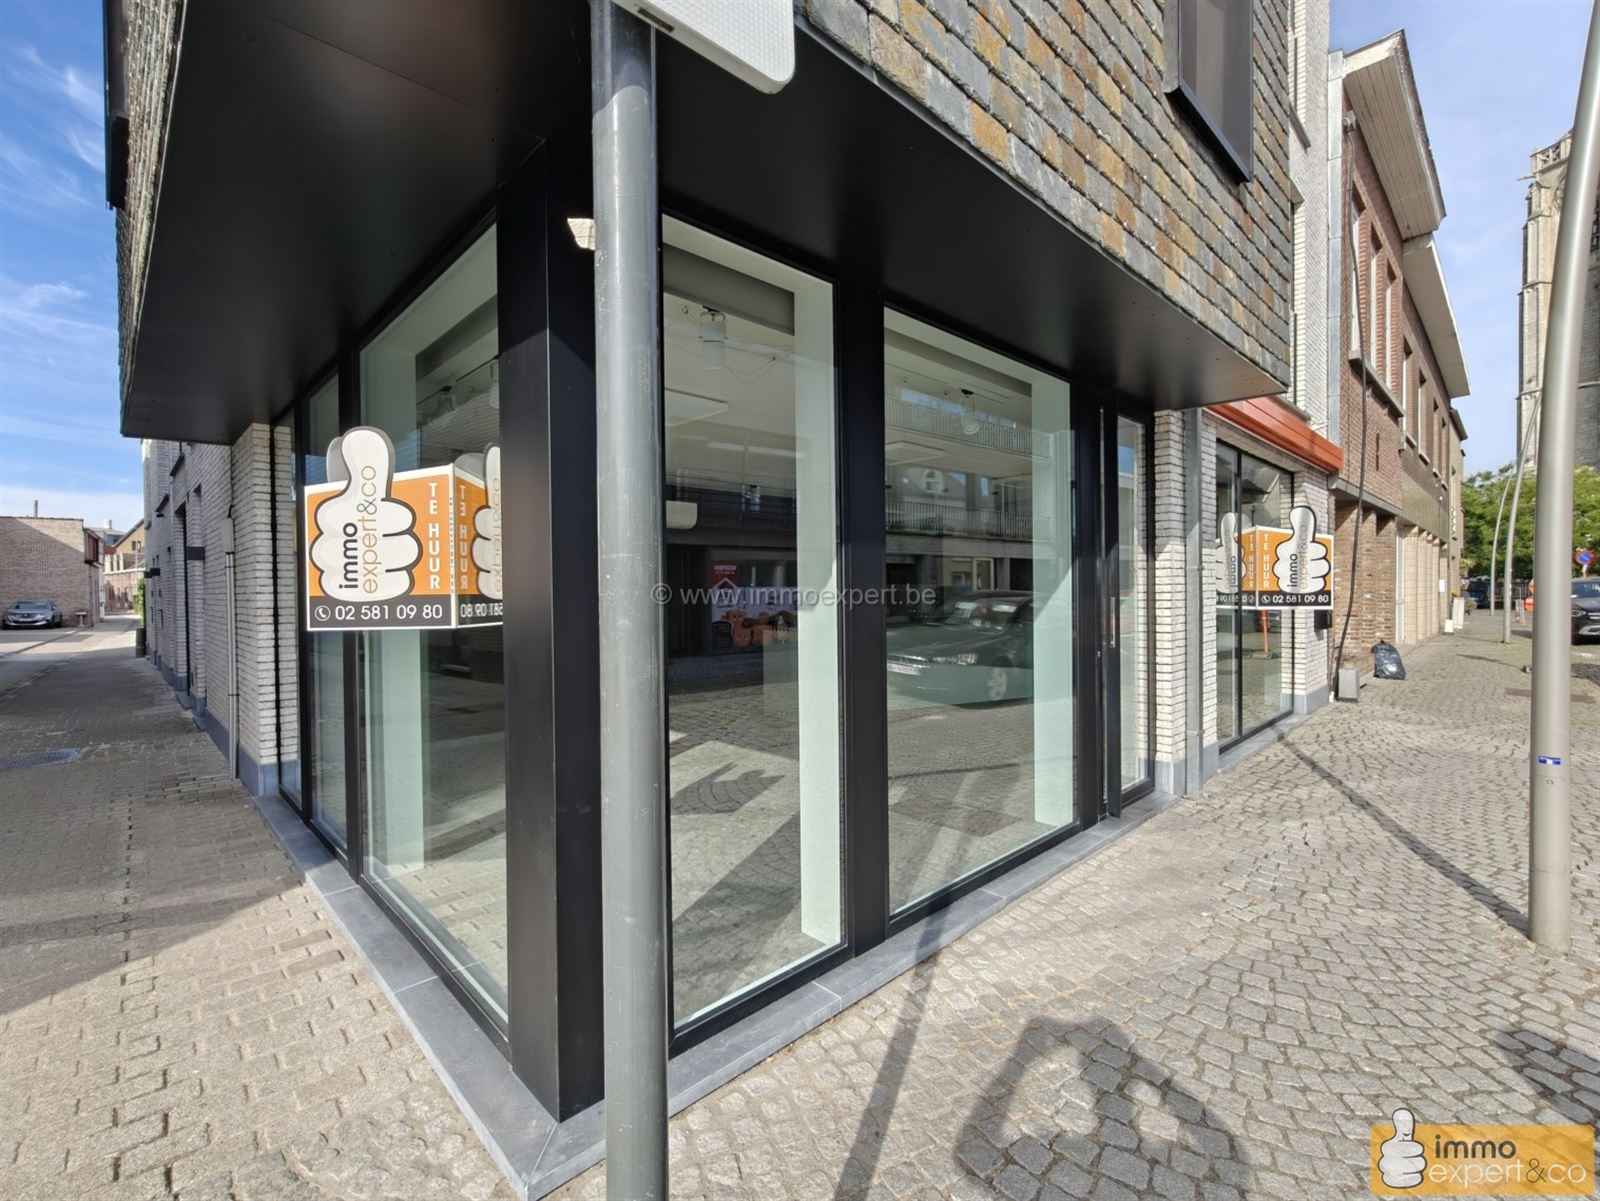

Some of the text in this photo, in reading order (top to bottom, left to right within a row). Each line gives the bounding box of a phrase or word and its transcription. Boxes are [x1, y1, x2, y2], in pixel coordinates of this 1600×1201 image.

[357, 465, 382, 594] expert&co
[428, 482, 441, 590] TE HUUR
[338, 522, 358, 589] immo
[1287, 553, 1298, 588] immo
[335, 604, 443, 620] 02 581 09 80
[1272, 594, 1329, 603] 02 581 09 80
